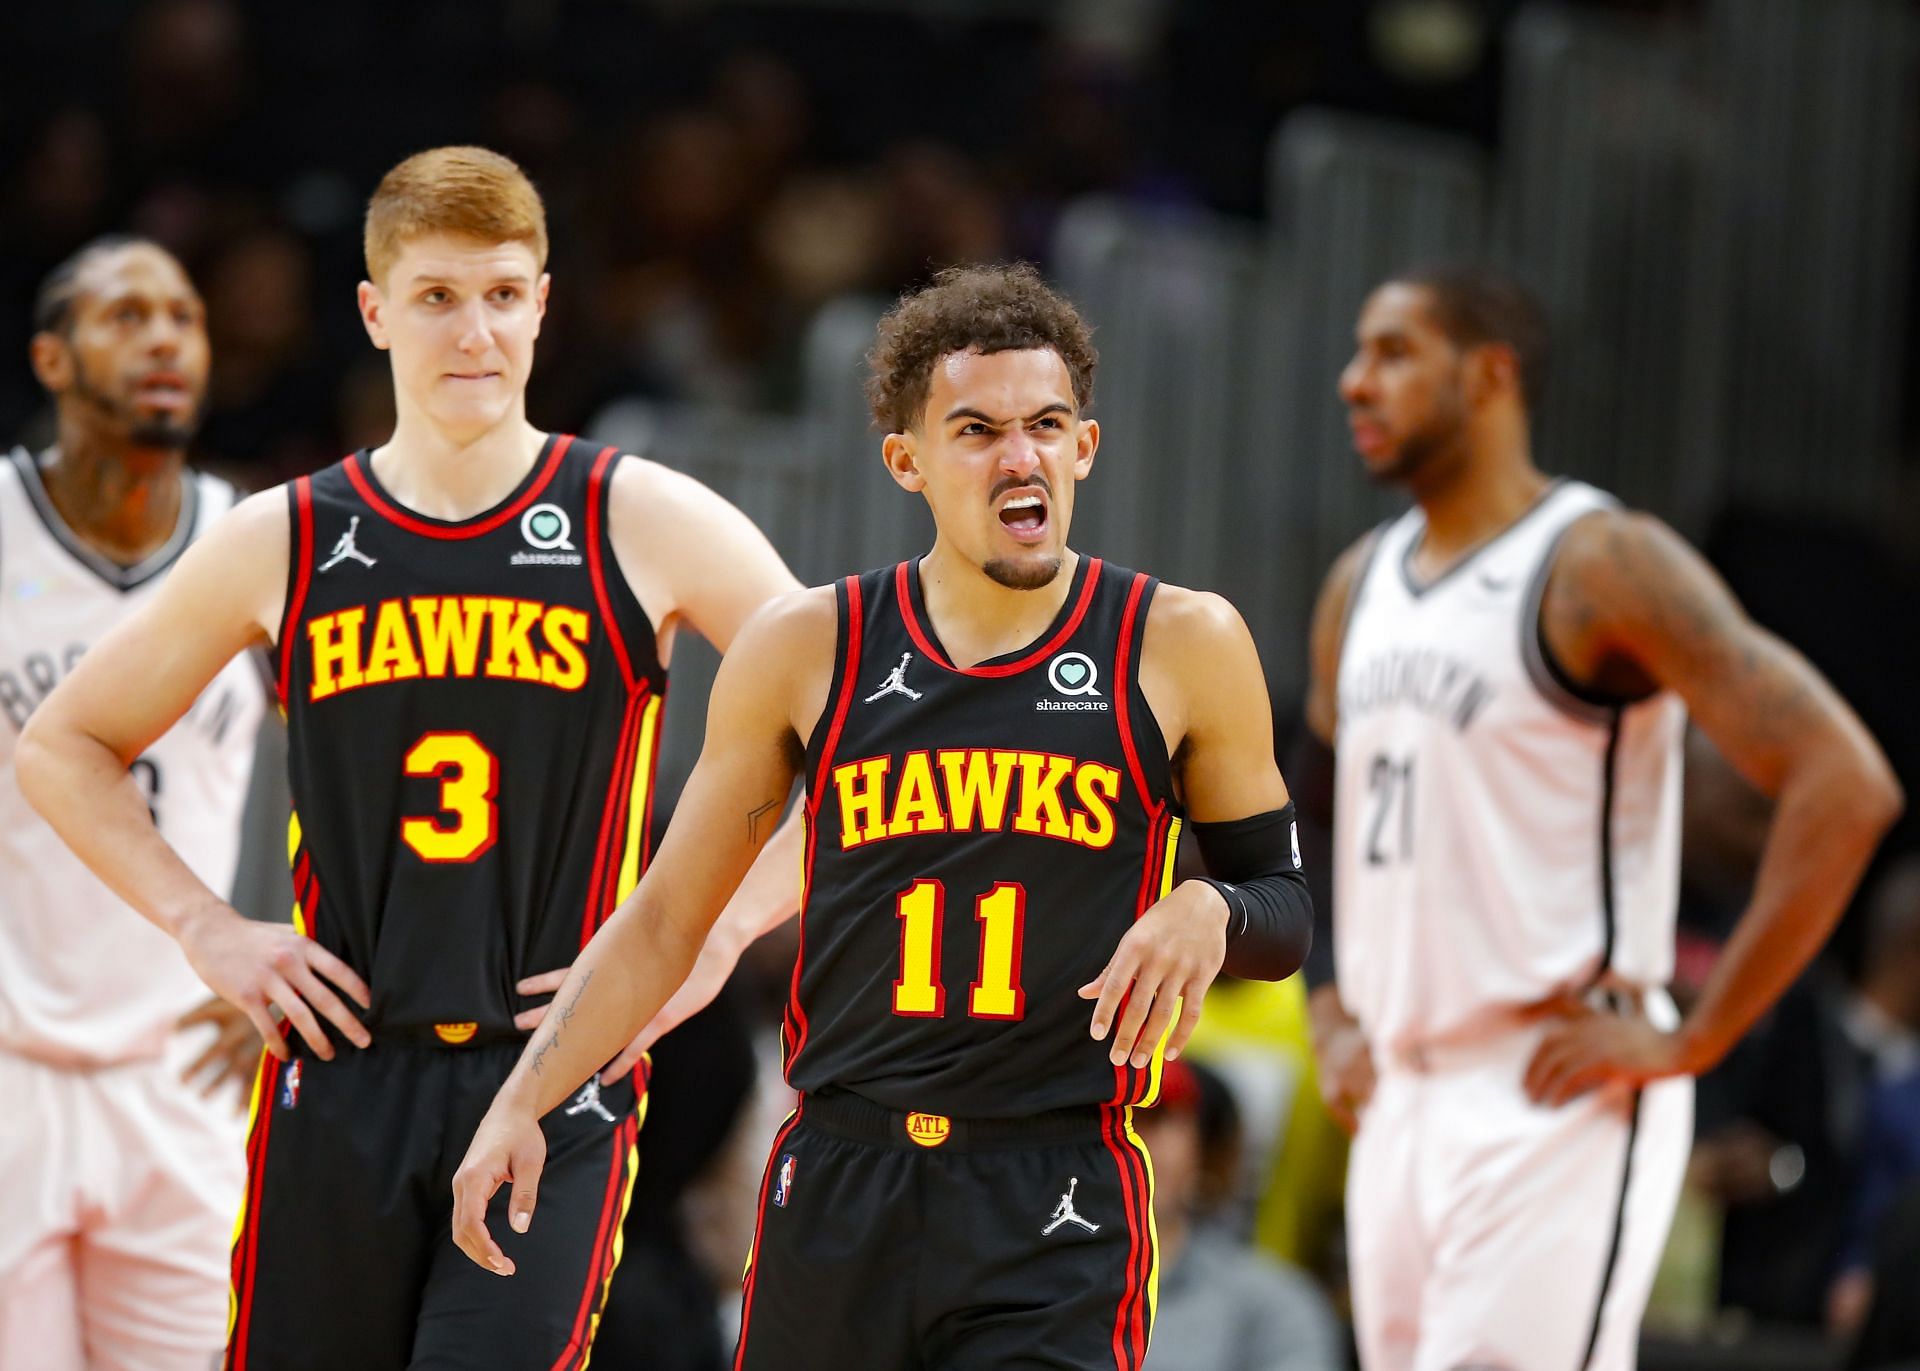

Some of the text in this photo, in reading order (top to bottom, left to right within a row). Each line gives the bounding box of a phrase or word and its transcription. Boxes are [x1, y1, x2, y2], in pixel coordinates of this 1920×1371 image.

[510, 551, 582, 566] sharecare
[306, 594, 591, 703] HAWKS
[1035, 698, 1109, 711] sharecare
[400, 729, 499, 864] 3
[832, 748, 1122, 852] HAWKS
[1364, 751, 1414, 868] 21
[891, 877, 1027, 1021] 11
[912, 1116, 945, 1134] ATL
